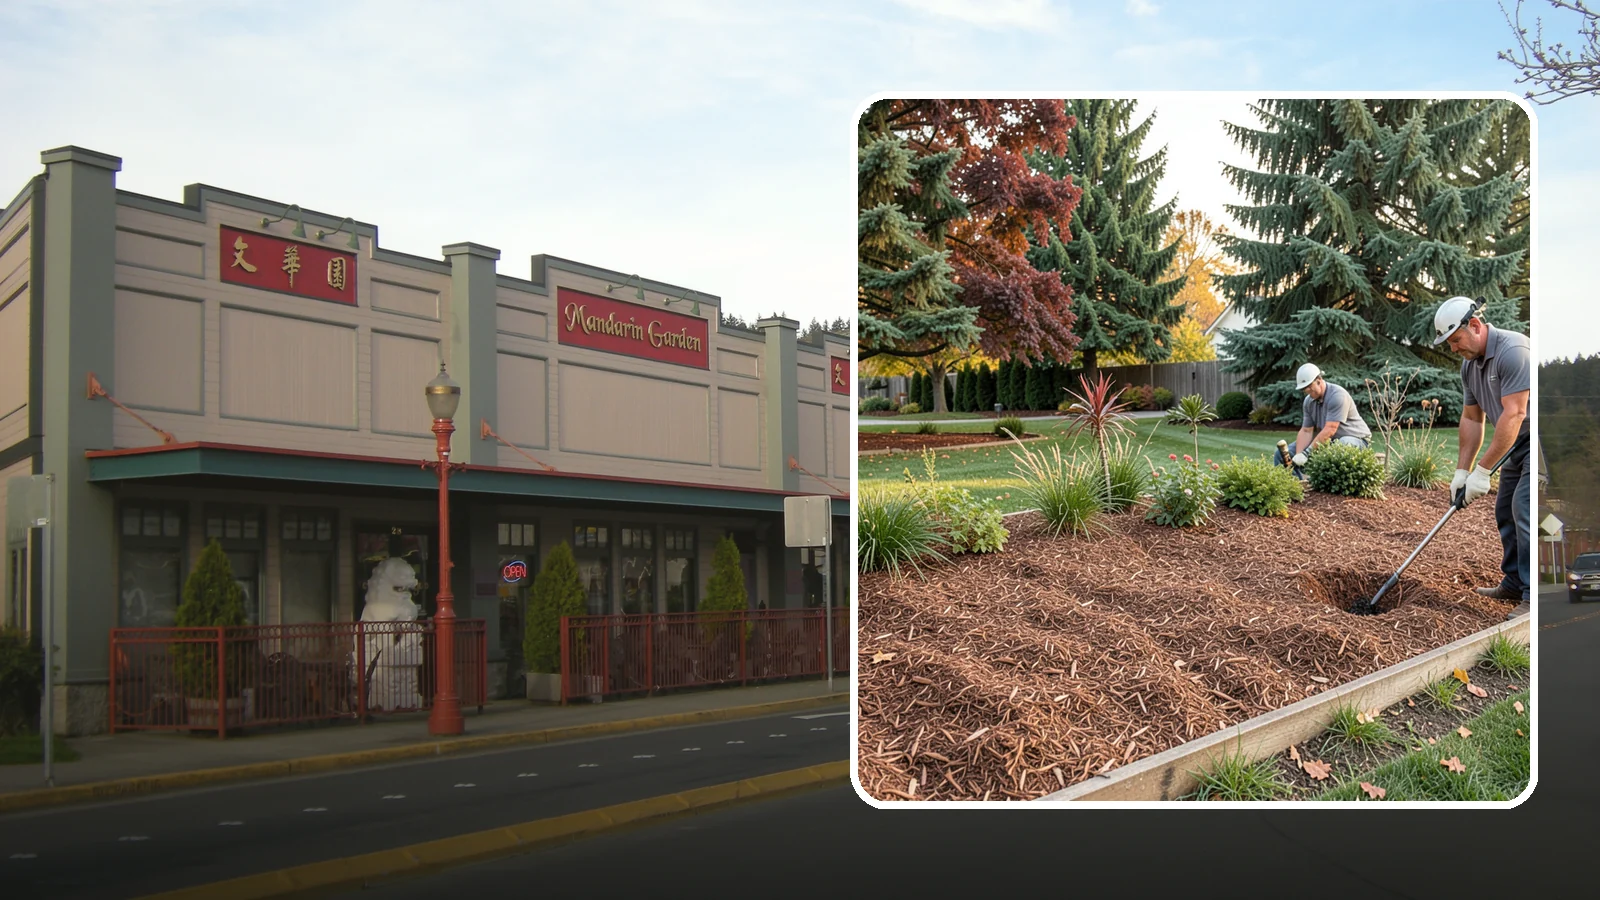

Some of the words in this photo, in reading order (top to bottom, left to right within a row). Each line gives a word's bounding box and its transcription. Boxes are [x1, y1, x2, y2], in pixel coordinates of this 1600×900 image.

[231, 235, 347, 291] 文華園
[564, 302, 644, 341] Mandarin
[648, 320, 702, 352] Garden
[503, 565, 527, 578] OPEN
